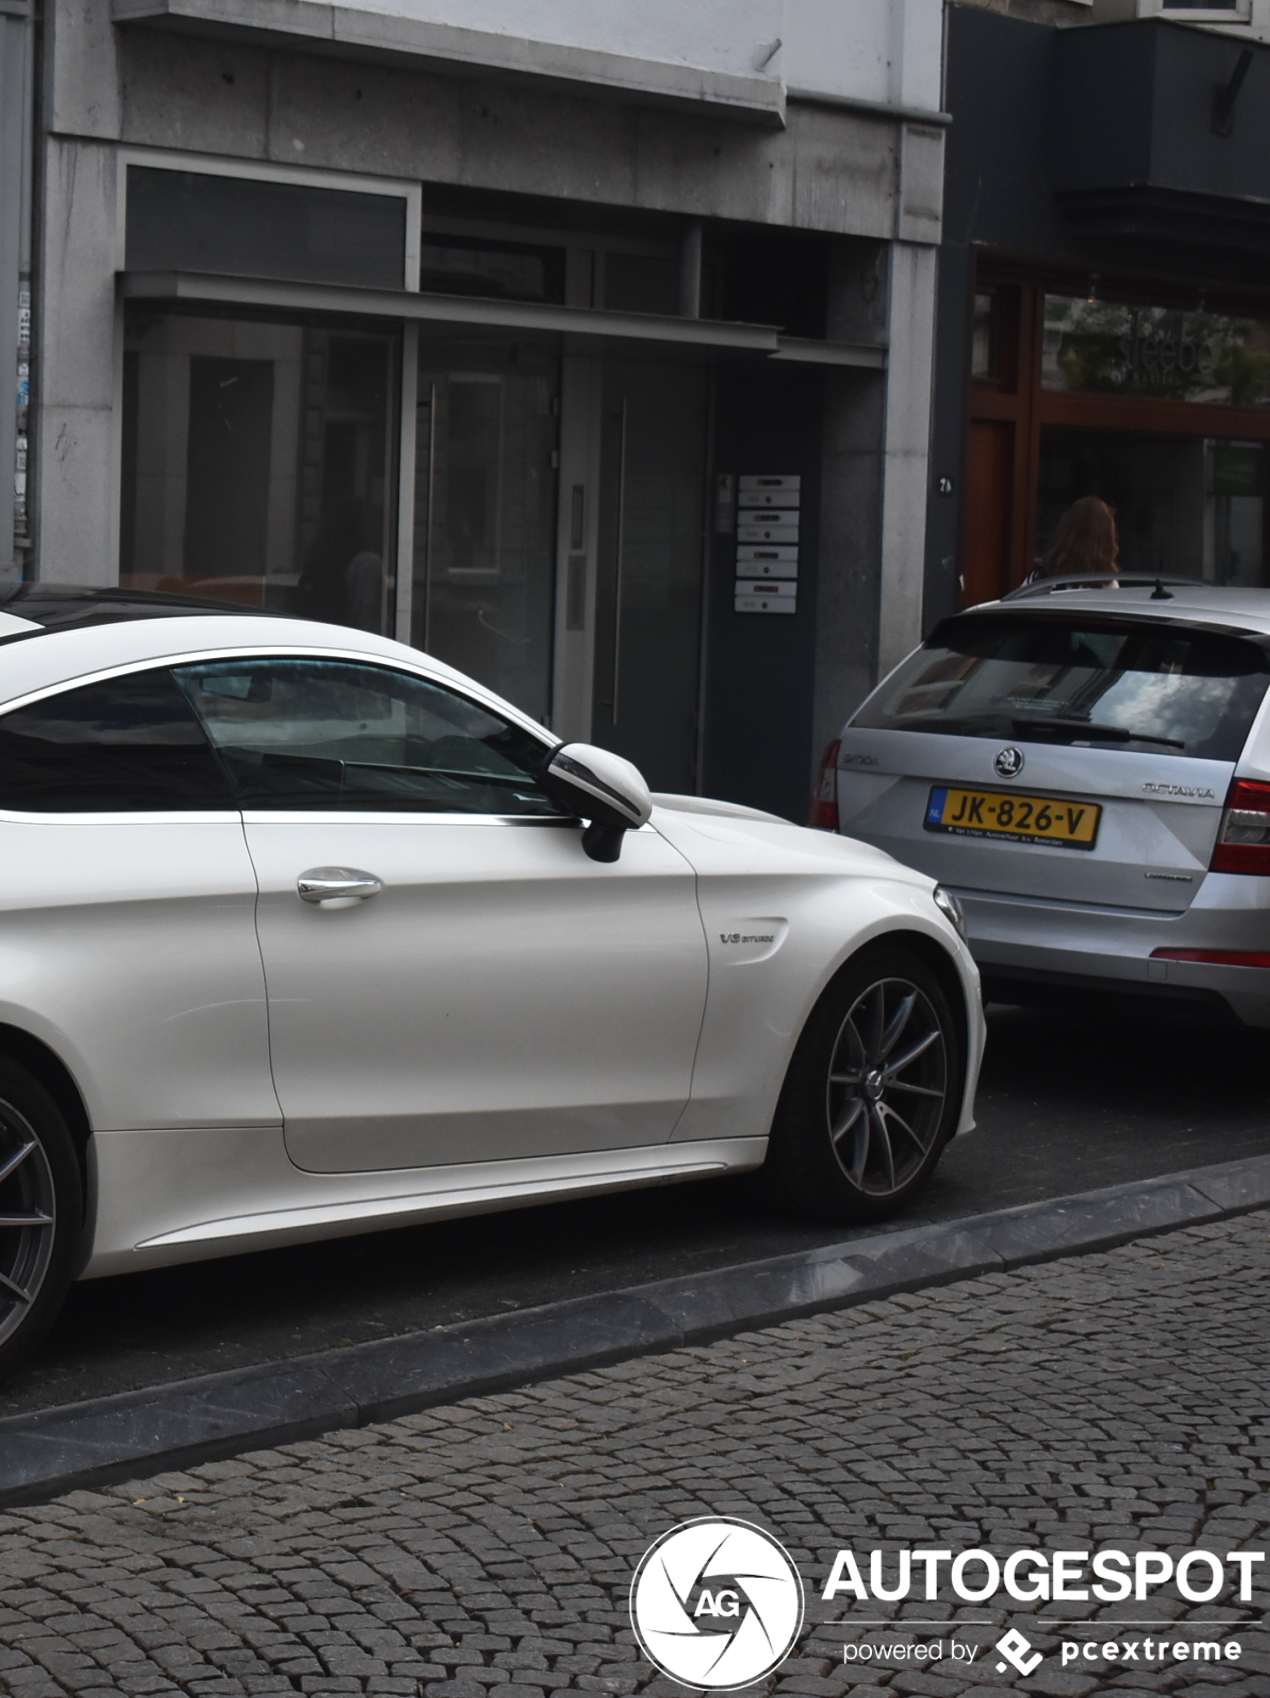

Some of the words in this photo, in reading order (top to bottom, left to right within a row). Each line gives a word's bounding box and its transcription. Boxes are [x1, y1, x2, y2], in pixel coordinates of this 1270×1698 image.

[1142, 782, 1215, 800] OCTAVIA
[929, 808, 940, 818] NL
[951, 794, 1086, 836] JK-826-V
